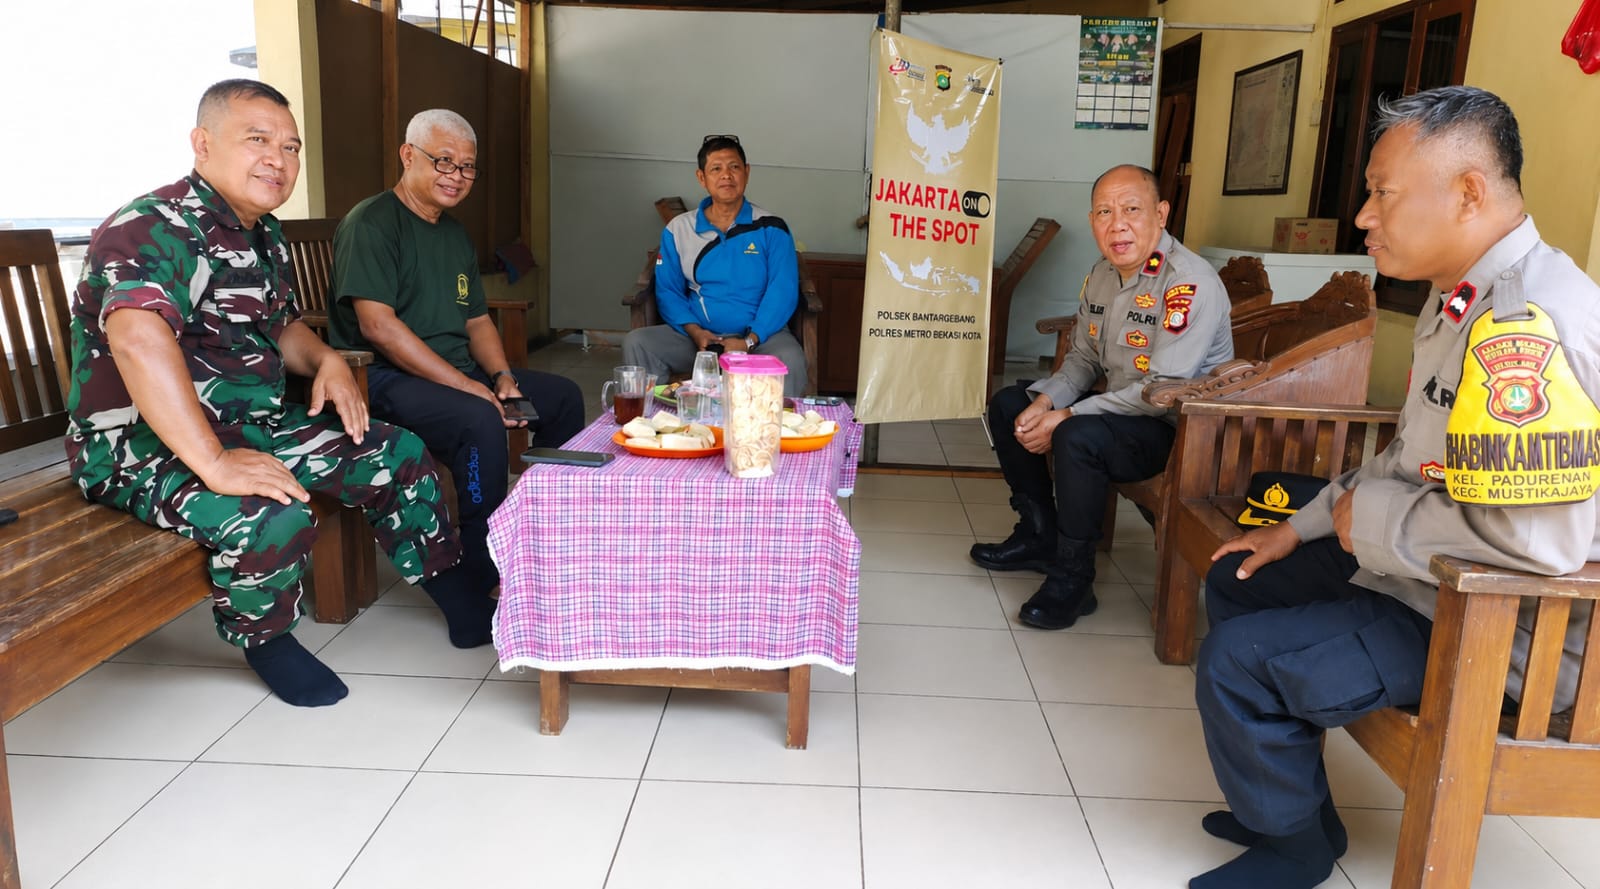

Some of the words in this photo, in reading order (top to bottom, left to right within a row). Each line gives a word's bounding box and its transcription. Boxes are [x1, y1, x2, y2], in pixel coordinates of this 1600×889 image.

[875, 178, 961, 212] JAKARTA
[963, 196, 978, 210] ON
[889, 213, 927, 241] THE
[931, 218, 980, 246] SPOT
[877, 310, 911, 321] POLSEK
[912, 312, 976, 324] BANTARGEBANG
[1126, 310, 1157, 326] POLRI
[869, 328, 903, 338] POLRES
[904, 329, 932, 339] METRO
[933, 330, 961, 340] BEKASI
[962, 331, 982, 341] KOTA
[1453, 473, 1484, 486] KEL.
[1491, 471, 1591, 486] PADURENAN
[1452, 486, 1482, 499] KEC.
[1488, 484, 1593, 499] MUSTIKAJAYA
